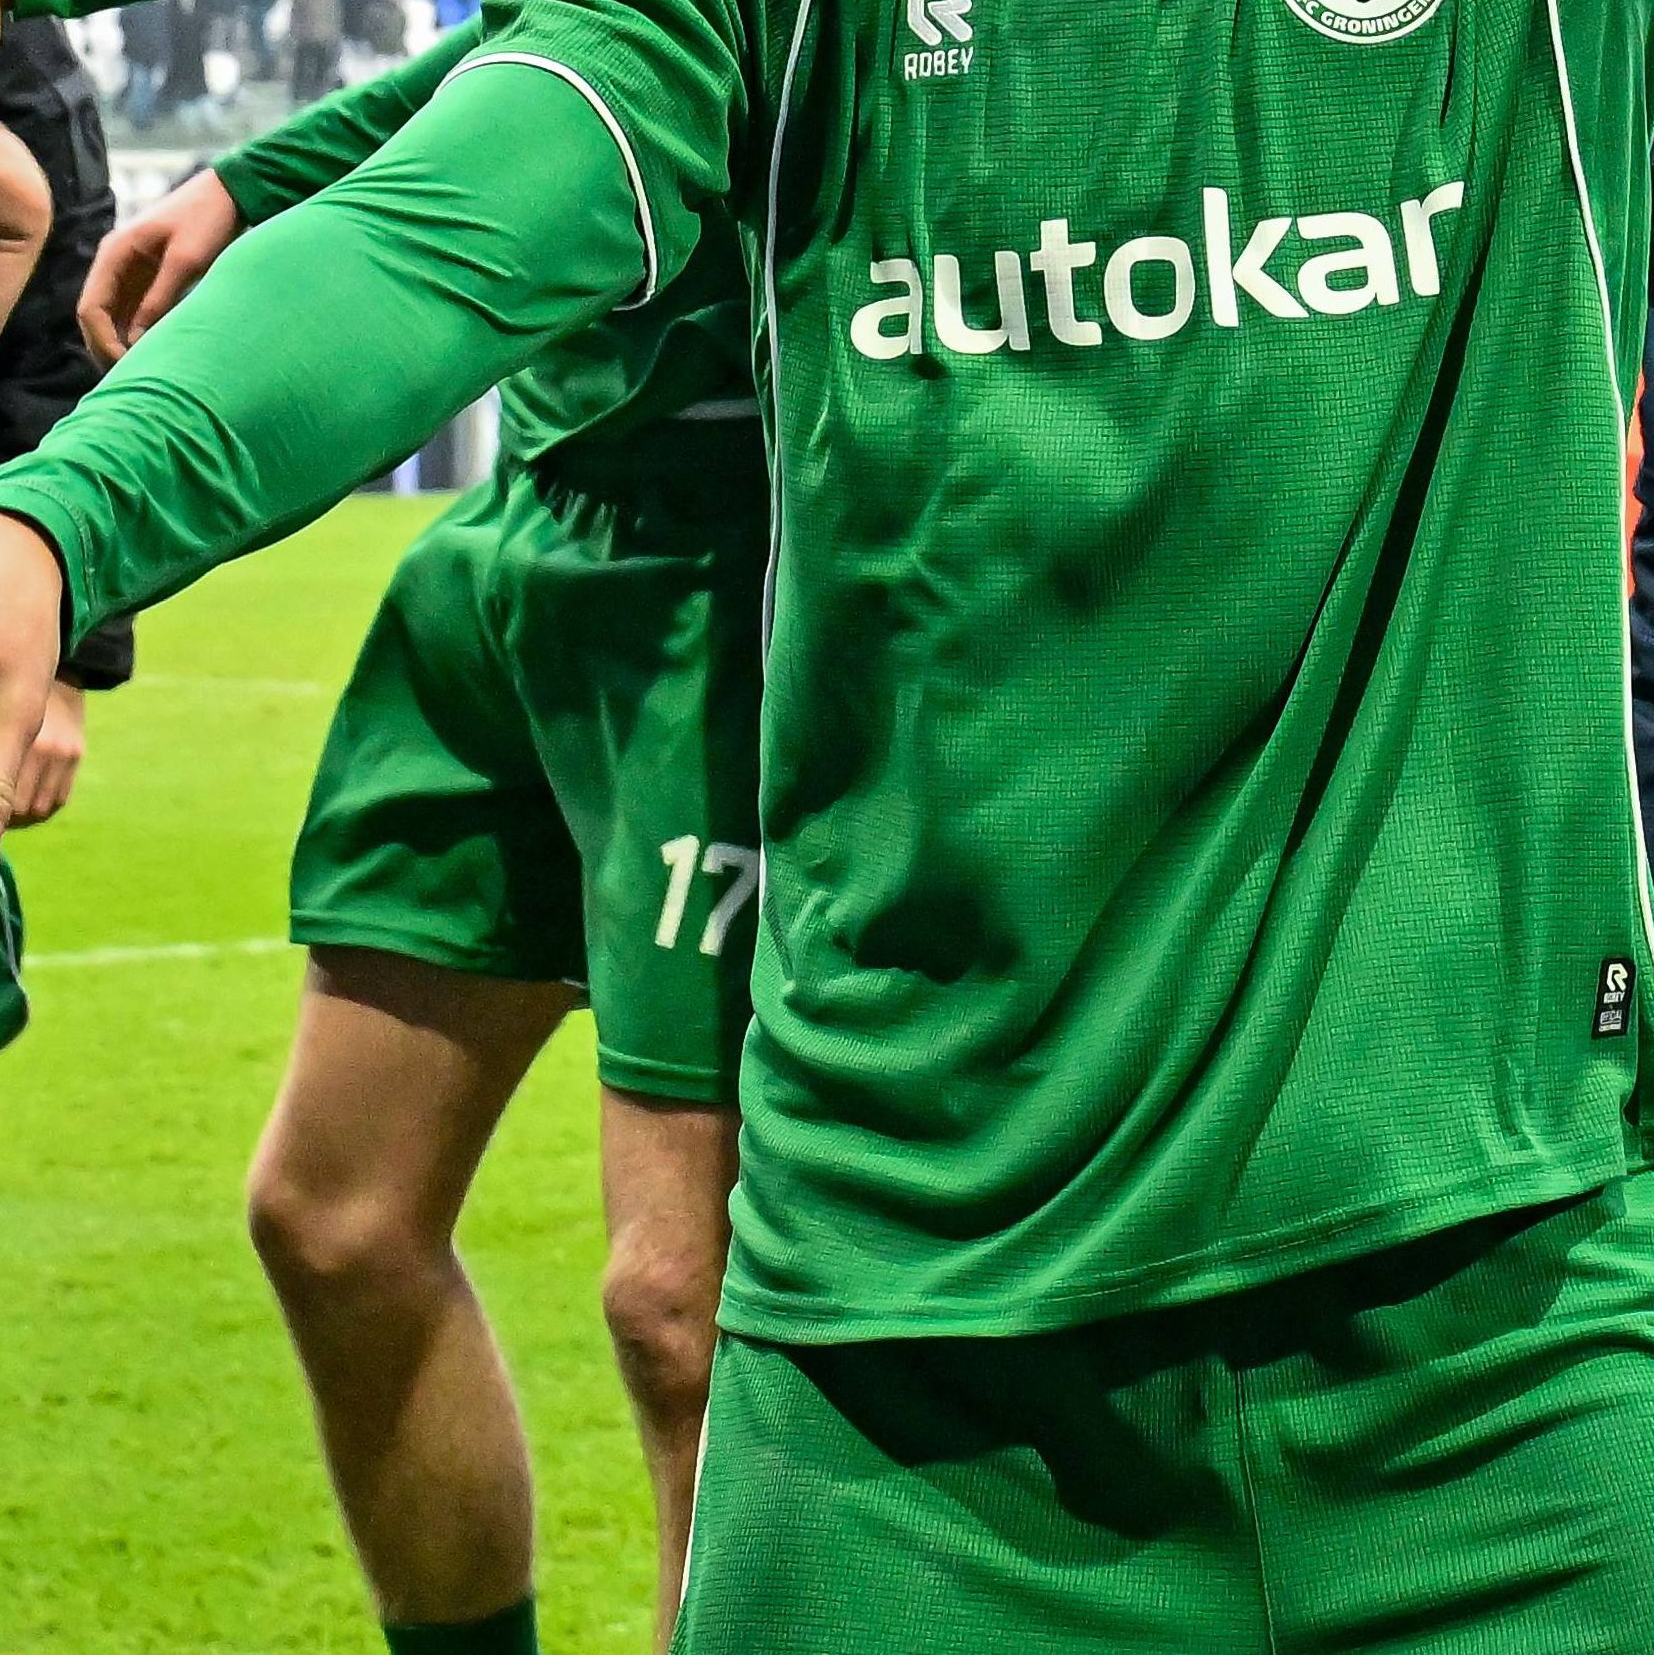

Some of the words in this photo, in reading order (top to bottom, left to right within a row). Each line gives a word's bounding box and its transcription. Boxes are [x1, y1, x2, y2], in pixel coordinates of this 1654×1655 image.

[905, 46, 974, 81] ROBEY
[848, 180, 1465, 360] autokar
[658, 833, 762, 957] 17
